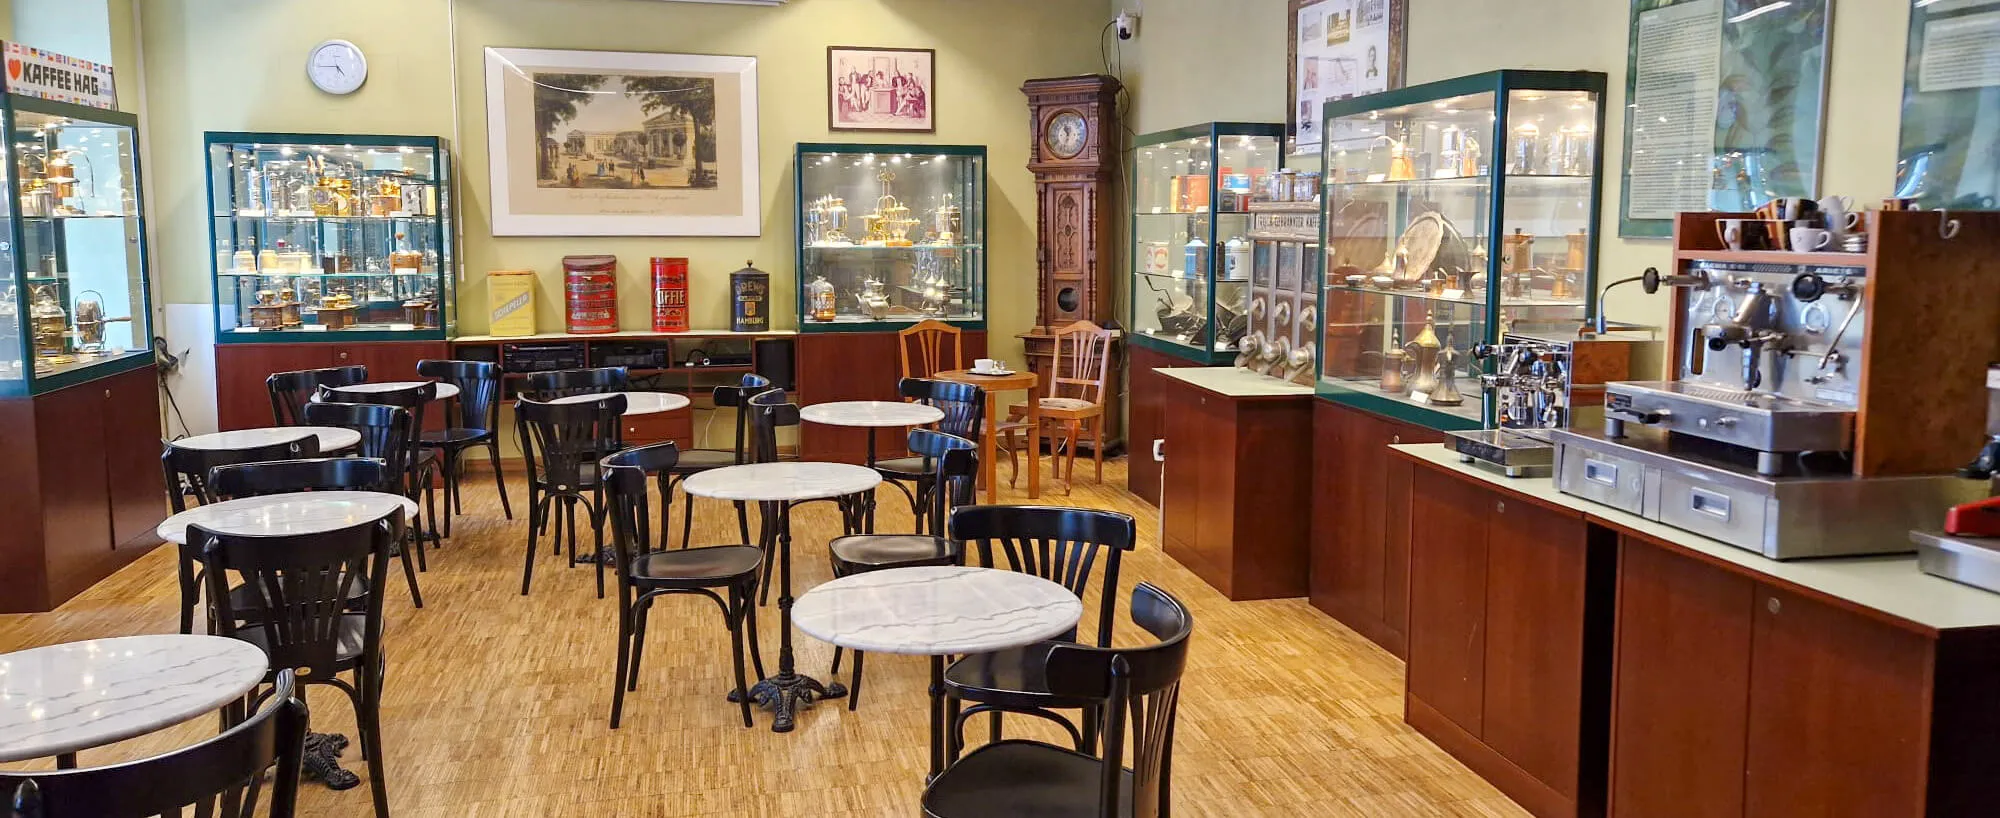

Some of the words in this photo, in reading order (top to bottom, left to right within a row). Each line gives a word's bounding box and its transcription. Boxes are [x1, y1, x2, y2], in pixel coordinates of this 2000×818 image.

[23, 61, 71, 91] KAFFEE
[74, 73, 99, 96] HAG
[736, 317, 764, 325] HAMBURG
